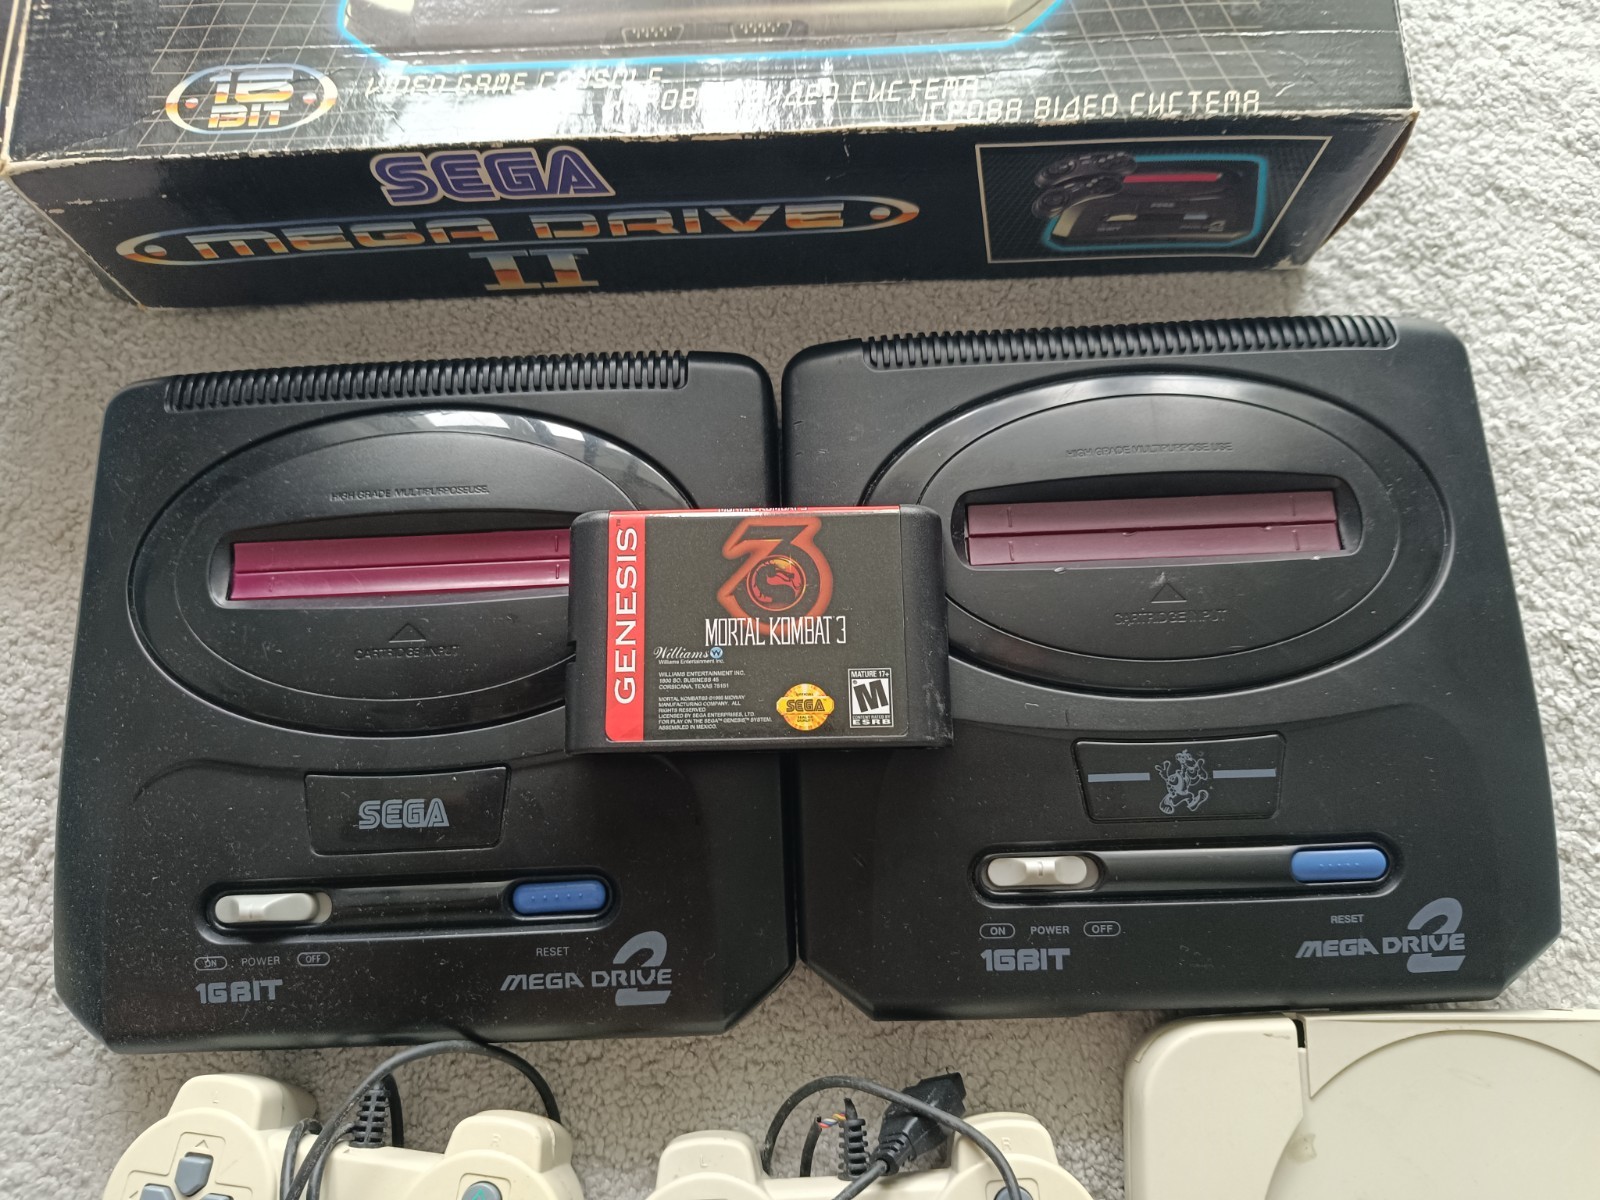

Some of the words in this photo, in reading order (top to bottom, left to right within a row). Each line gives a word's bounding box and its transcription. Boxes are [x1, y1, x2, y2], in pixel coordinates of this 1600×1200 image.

[209, 69, 295, 104] 16
[1129, 89, 1261, 117] СИСТЕМА
[207, 102, 290, 129] BIT
[370, 146, 616, 206] SEGA
[185, 217, 500, 259] MEGA
[529, 202, 844, 239] DRIVE
[468, 248, 599, 291] II
[1094, 445, 1132, 457] GRADE
[329, 491, 355, 502] HIGH
[357, 487, 391, 501] GRADE
[614, 527, 639, 705] GENESIS
[704, 617, 766, 647] MORTAL
[768, 615, 833, 646] KOMBAT
[835, 615, 847, 645] 3
[653, 646, 709, 659] Williams
[786, 698, 826, 713] SEGA
[853, 679, 889, 713] M
[852, 718, 892, 726] ESRB
[358, 798, 449, 829] SEGA
[989, 926, 1006, 936] ON
[1030, 925, 1070, 936] POWER
[1091, 924, 1113, 935] OFF
[1330, 913, 1365, 924] RESET
[1382, 932, 1466, 955] DRIVE
[1406, 897, 1467, 974] 2
[536, 946, 571, 958] RESET
[1295, 937, 1380, 959] MEGA
[204, 956, 218, 968] ON
[241, 955, 281, 967] POWER
[305, 953, 322, 964] OFF
[612, 930, 672, 1007] 2
[500, 971, 585, 992] MEGA
[591, 967, 673, 988] DRIVE
